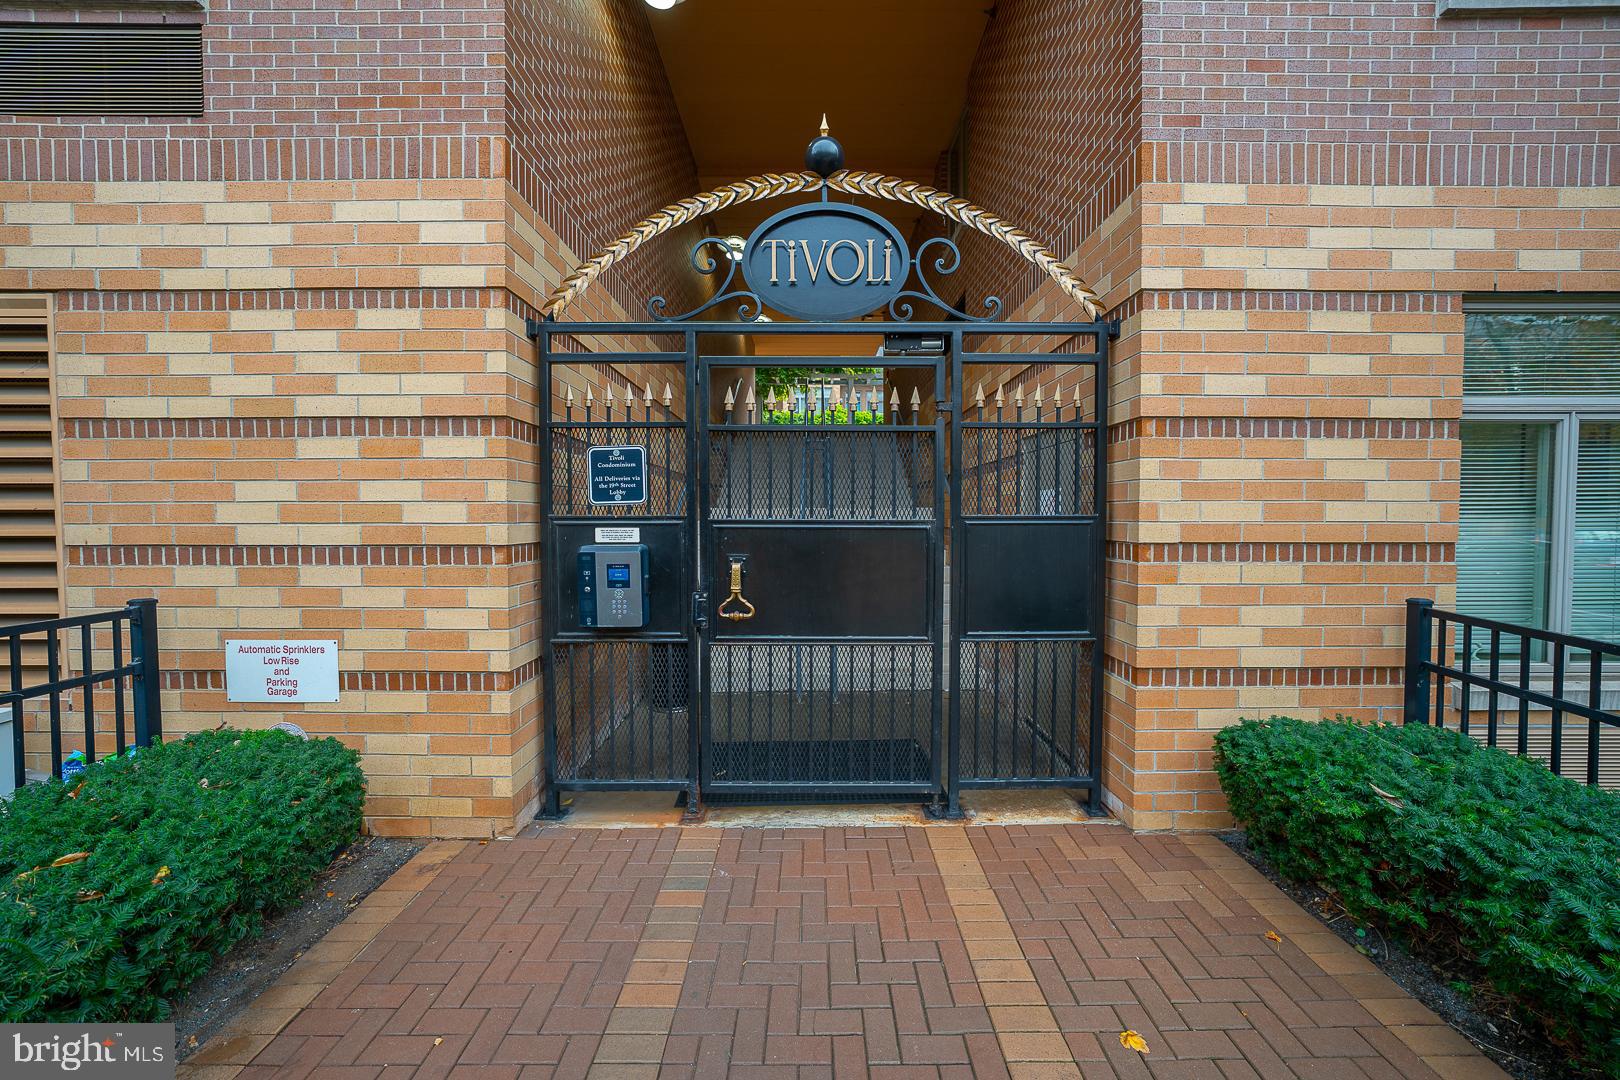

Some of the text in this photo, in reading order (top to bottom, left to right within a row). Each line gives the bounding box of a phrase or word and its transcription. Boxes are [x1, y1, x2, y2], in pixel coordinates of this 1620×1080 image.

[238, 645, 325, 655] Automatic Sprinklers
[263, 656, 299, 665] Low Rise
[273, 667, 290, 676] and
[266, 677, 298, 688] Parking
[267, 687, 298, 697] Garage
